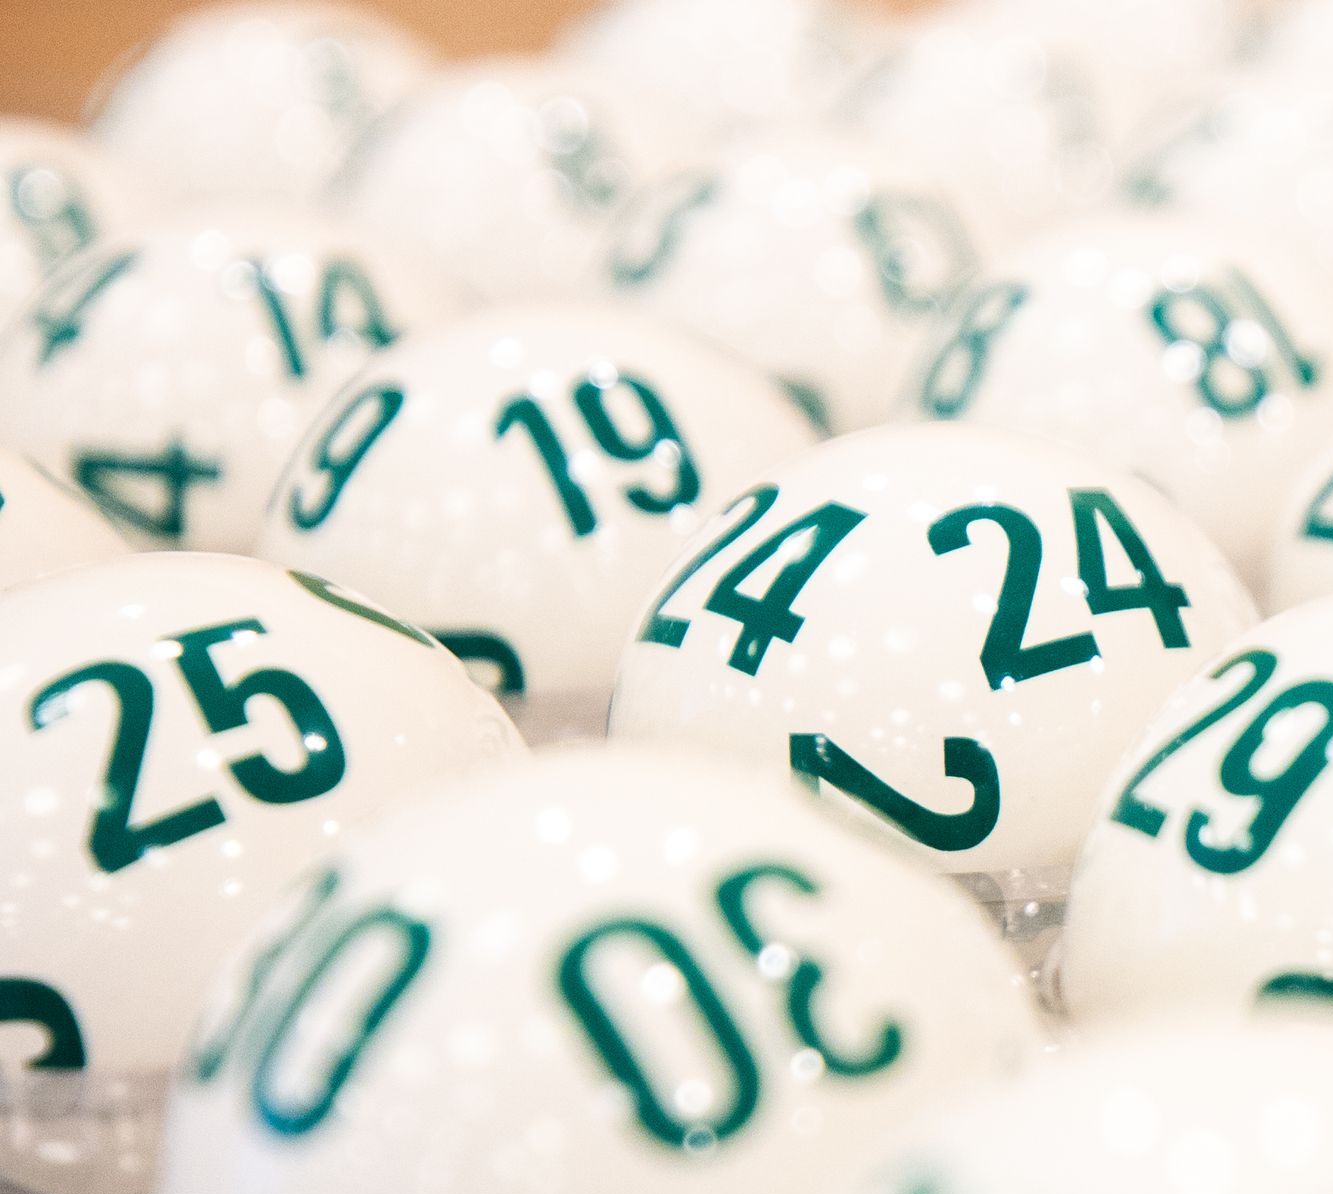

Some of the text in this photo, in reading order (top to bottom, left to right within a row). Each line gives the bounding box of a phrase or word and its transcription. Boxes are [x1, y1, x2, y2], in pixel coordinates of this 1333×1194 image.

[494, 370, 702, 538] 19
[635, 483, 869, 677] 24
[927, 486, 1193, 692] 24
[28, 616, 348, 875] 25
[553, 863, 906, 1152] 30
